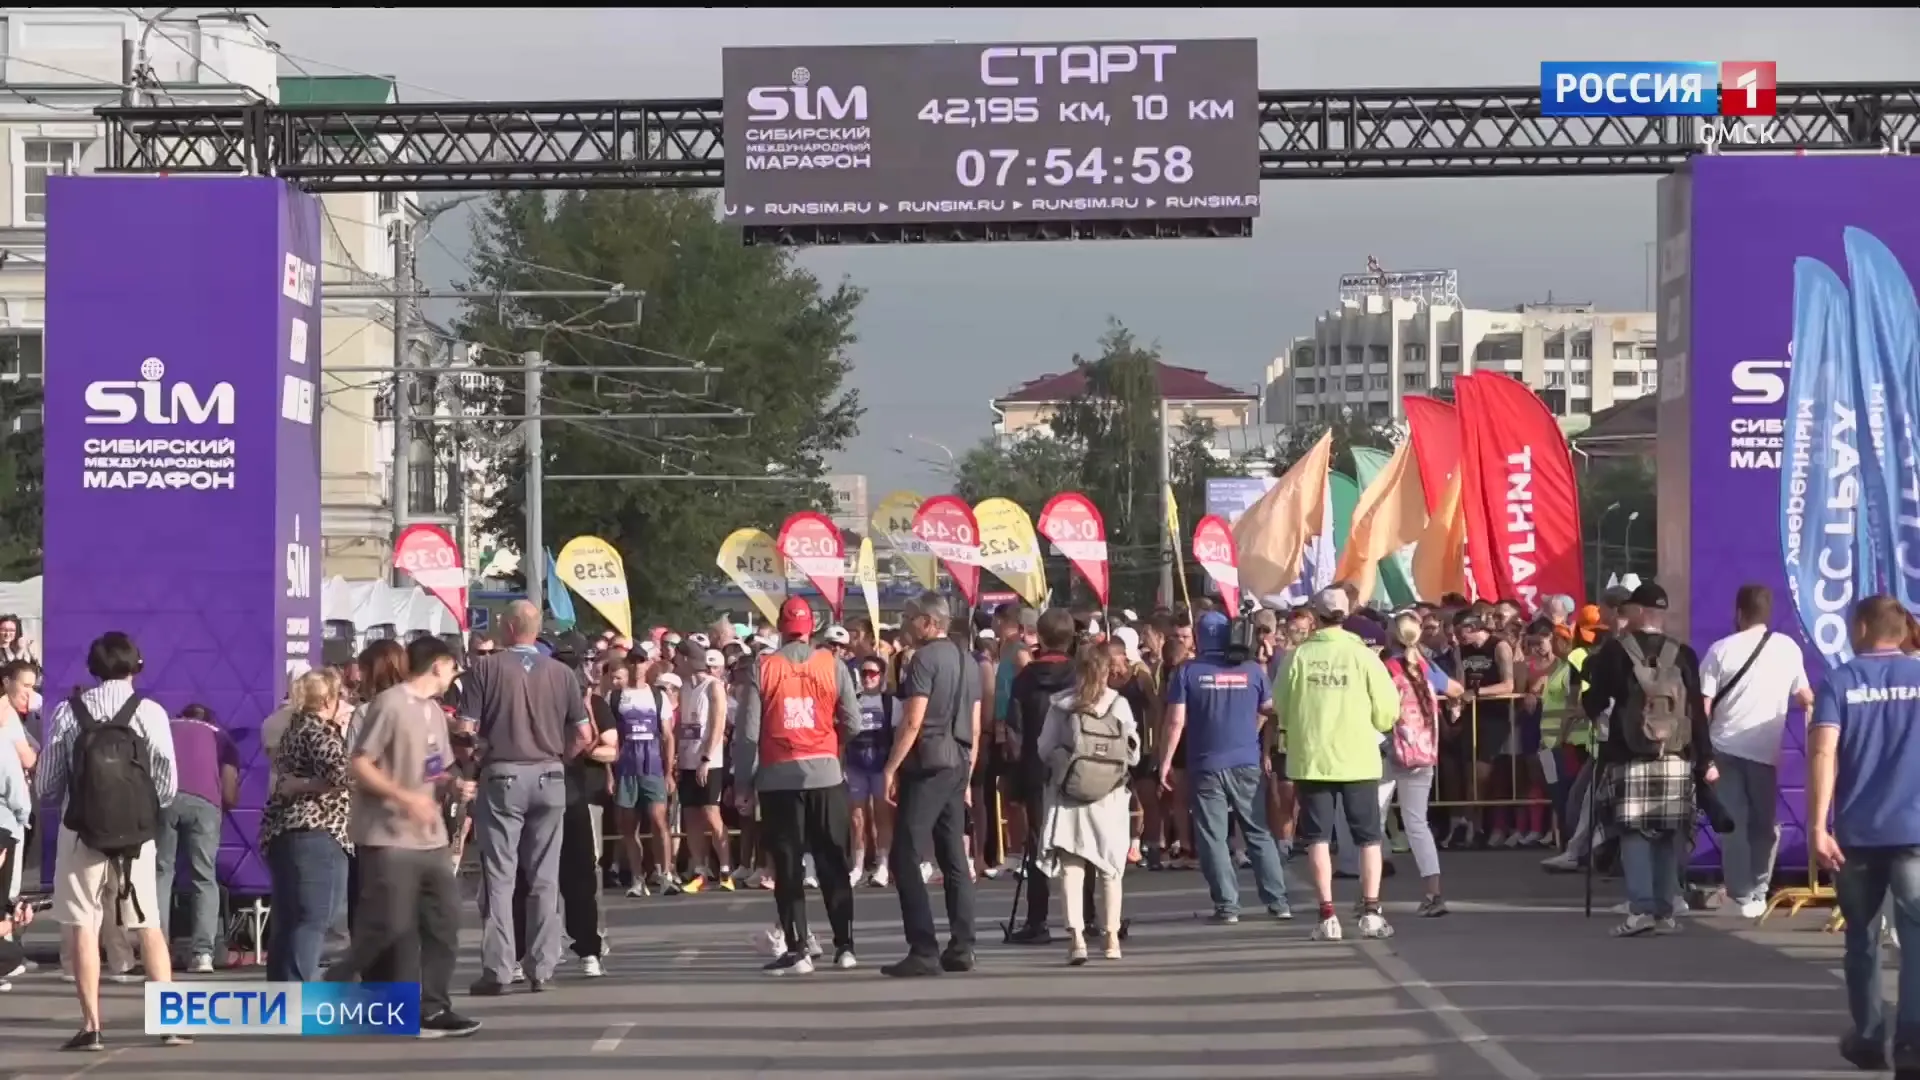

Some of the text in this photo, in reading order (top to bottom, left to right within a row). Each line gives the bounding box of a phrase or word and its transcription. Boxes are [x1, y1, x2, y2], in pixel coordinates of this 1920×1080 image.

[980, 45, 1177, 86] СТАРТ
[917, 97, 1040, 128] 42,195
[1132, 94, 1168, 121] 10
[745, 125, 871, 142] СИБИРСКИЙ
[746, 141, 871, 153] МЕЖДУНАРОДНЫЙ
[745, 154, 871, 170] МАРАФОН
[955, 144, 1194, 187] 07:54:58
[765, 195, 1260, 215] RUNSIM.RU RUNSIM.RU RUNSIM.RU RUNSIM.R
[83, 437, 235, 454] СИБИРСКИЙ
[84, 456, 235, 468] МЕЖДУНАРОДНЫЙ
[83, 470, 235, 489] МАРАФОН
